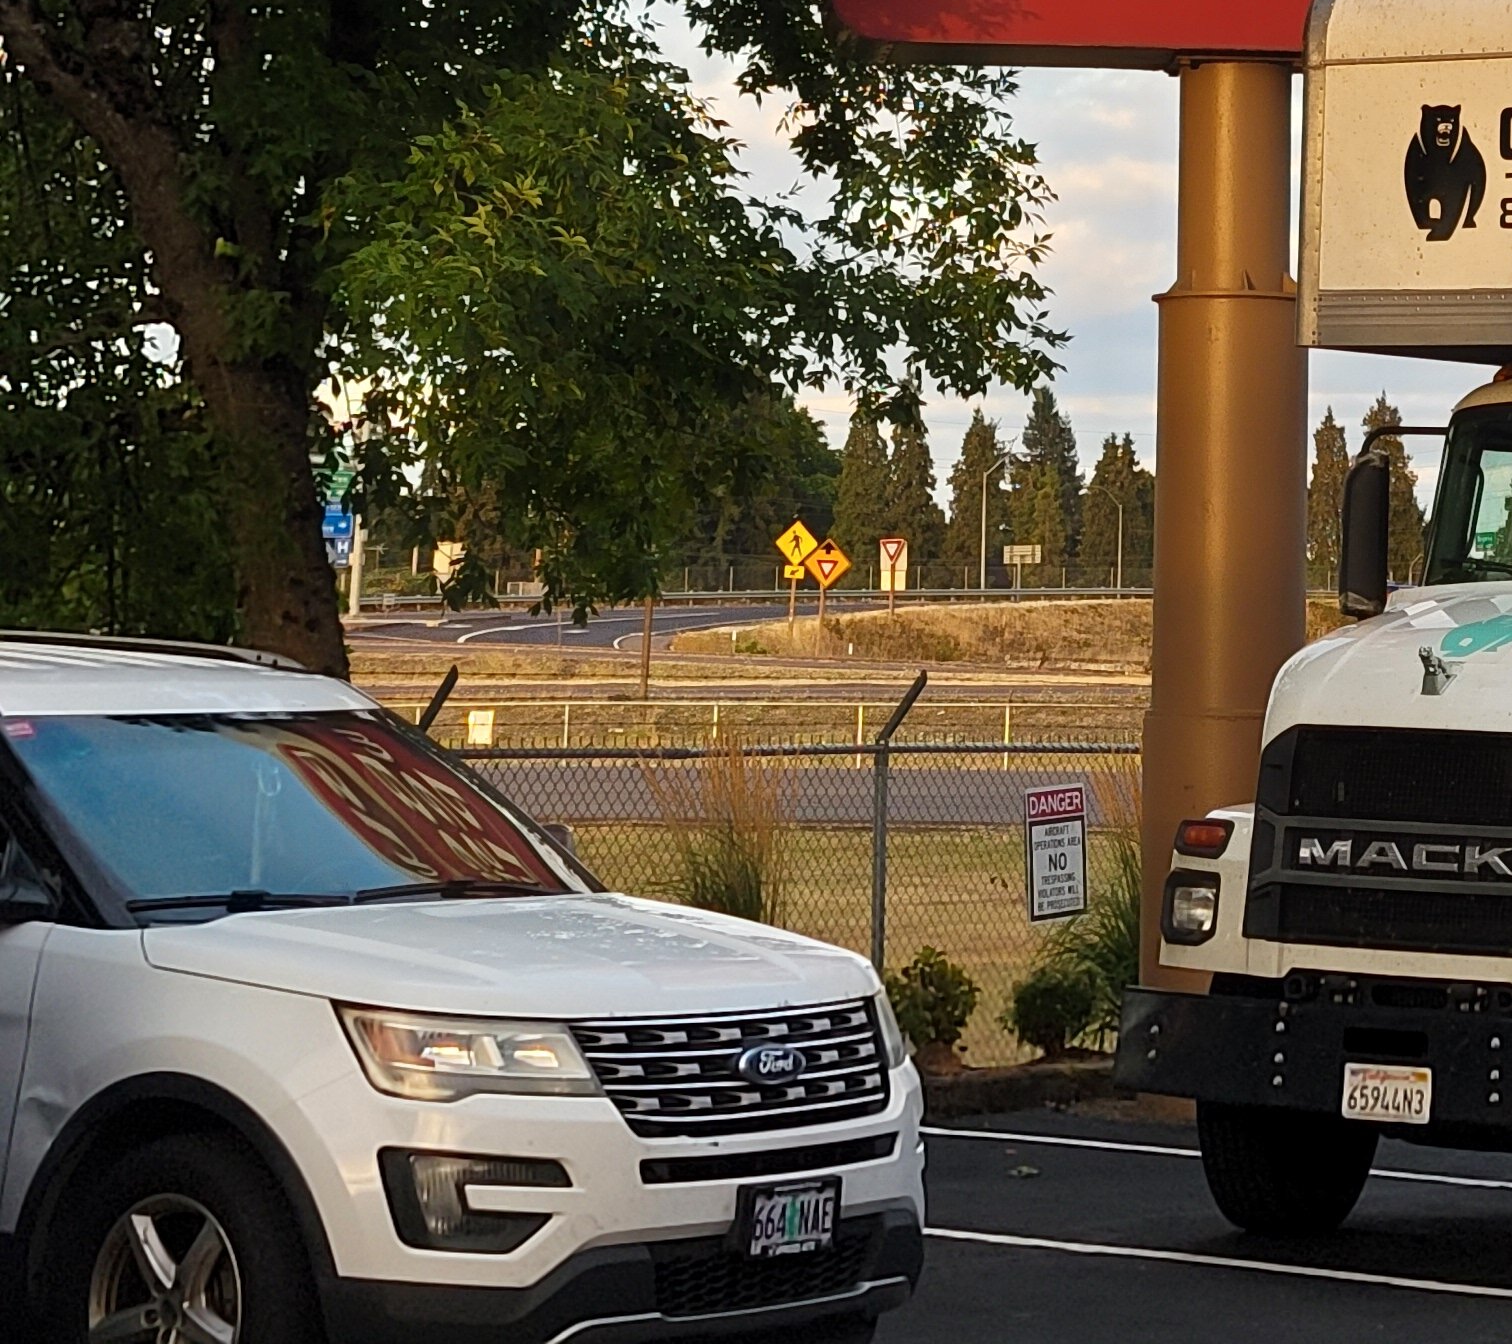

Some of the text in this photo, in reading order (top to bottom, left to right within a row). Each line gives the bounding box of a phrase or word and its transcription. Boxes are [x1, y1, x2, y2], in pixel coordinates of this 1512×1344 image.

[1029, 791, 1082, 815] DANGER
[1048, 852, 1067, 872] NO
[759, 1050, 794, 1074] Ford
[1347, 1084, 1425, 1115] 65944N3
[753, 1202, 787, 1241] 664
